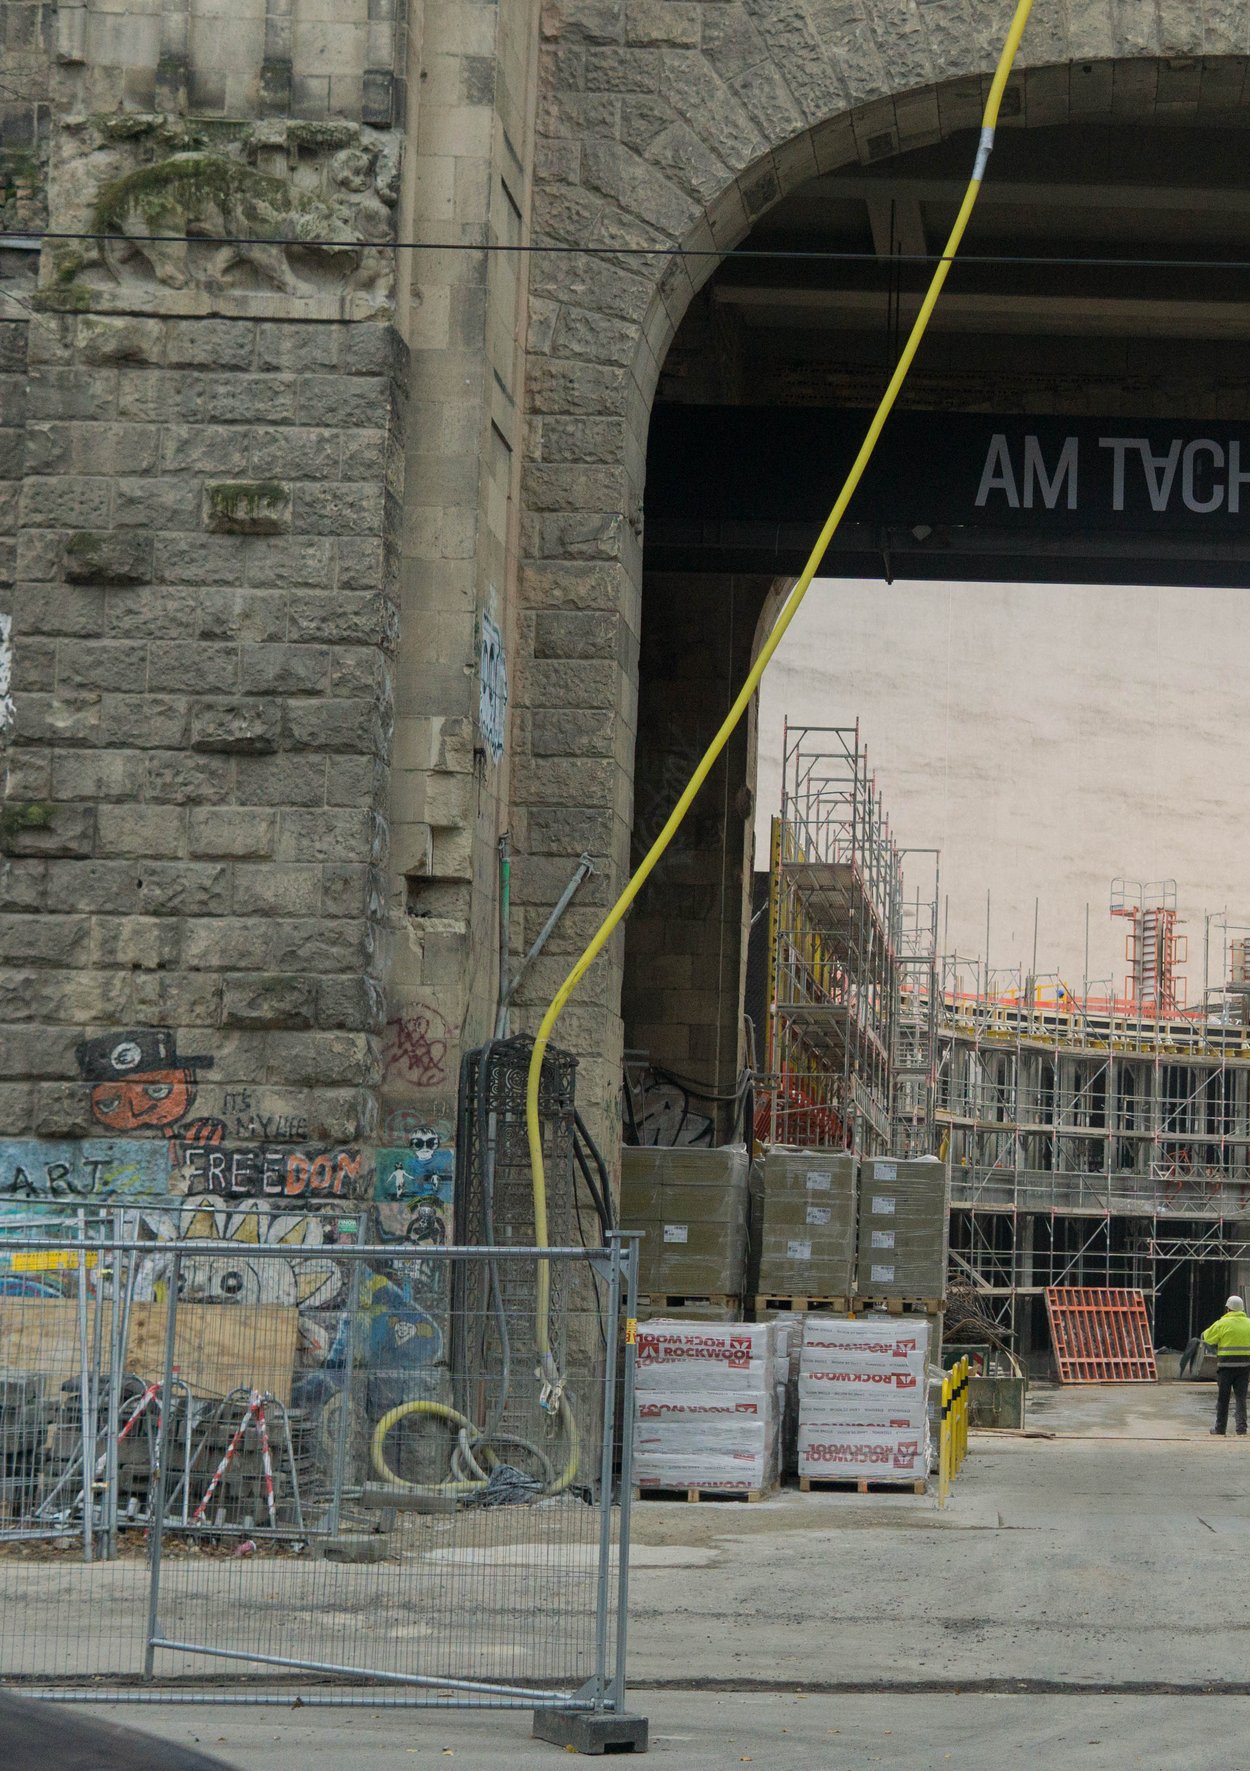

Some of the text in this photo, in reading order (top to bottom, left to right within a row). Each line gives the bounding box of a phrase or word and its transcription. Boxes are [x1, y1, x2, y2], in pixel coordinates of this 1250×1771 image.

[974, 433, 1079, 510] AM
[11, 1159, 114, 1196] ART
[663, 1346, 753, 1360] ROCKWOOL
